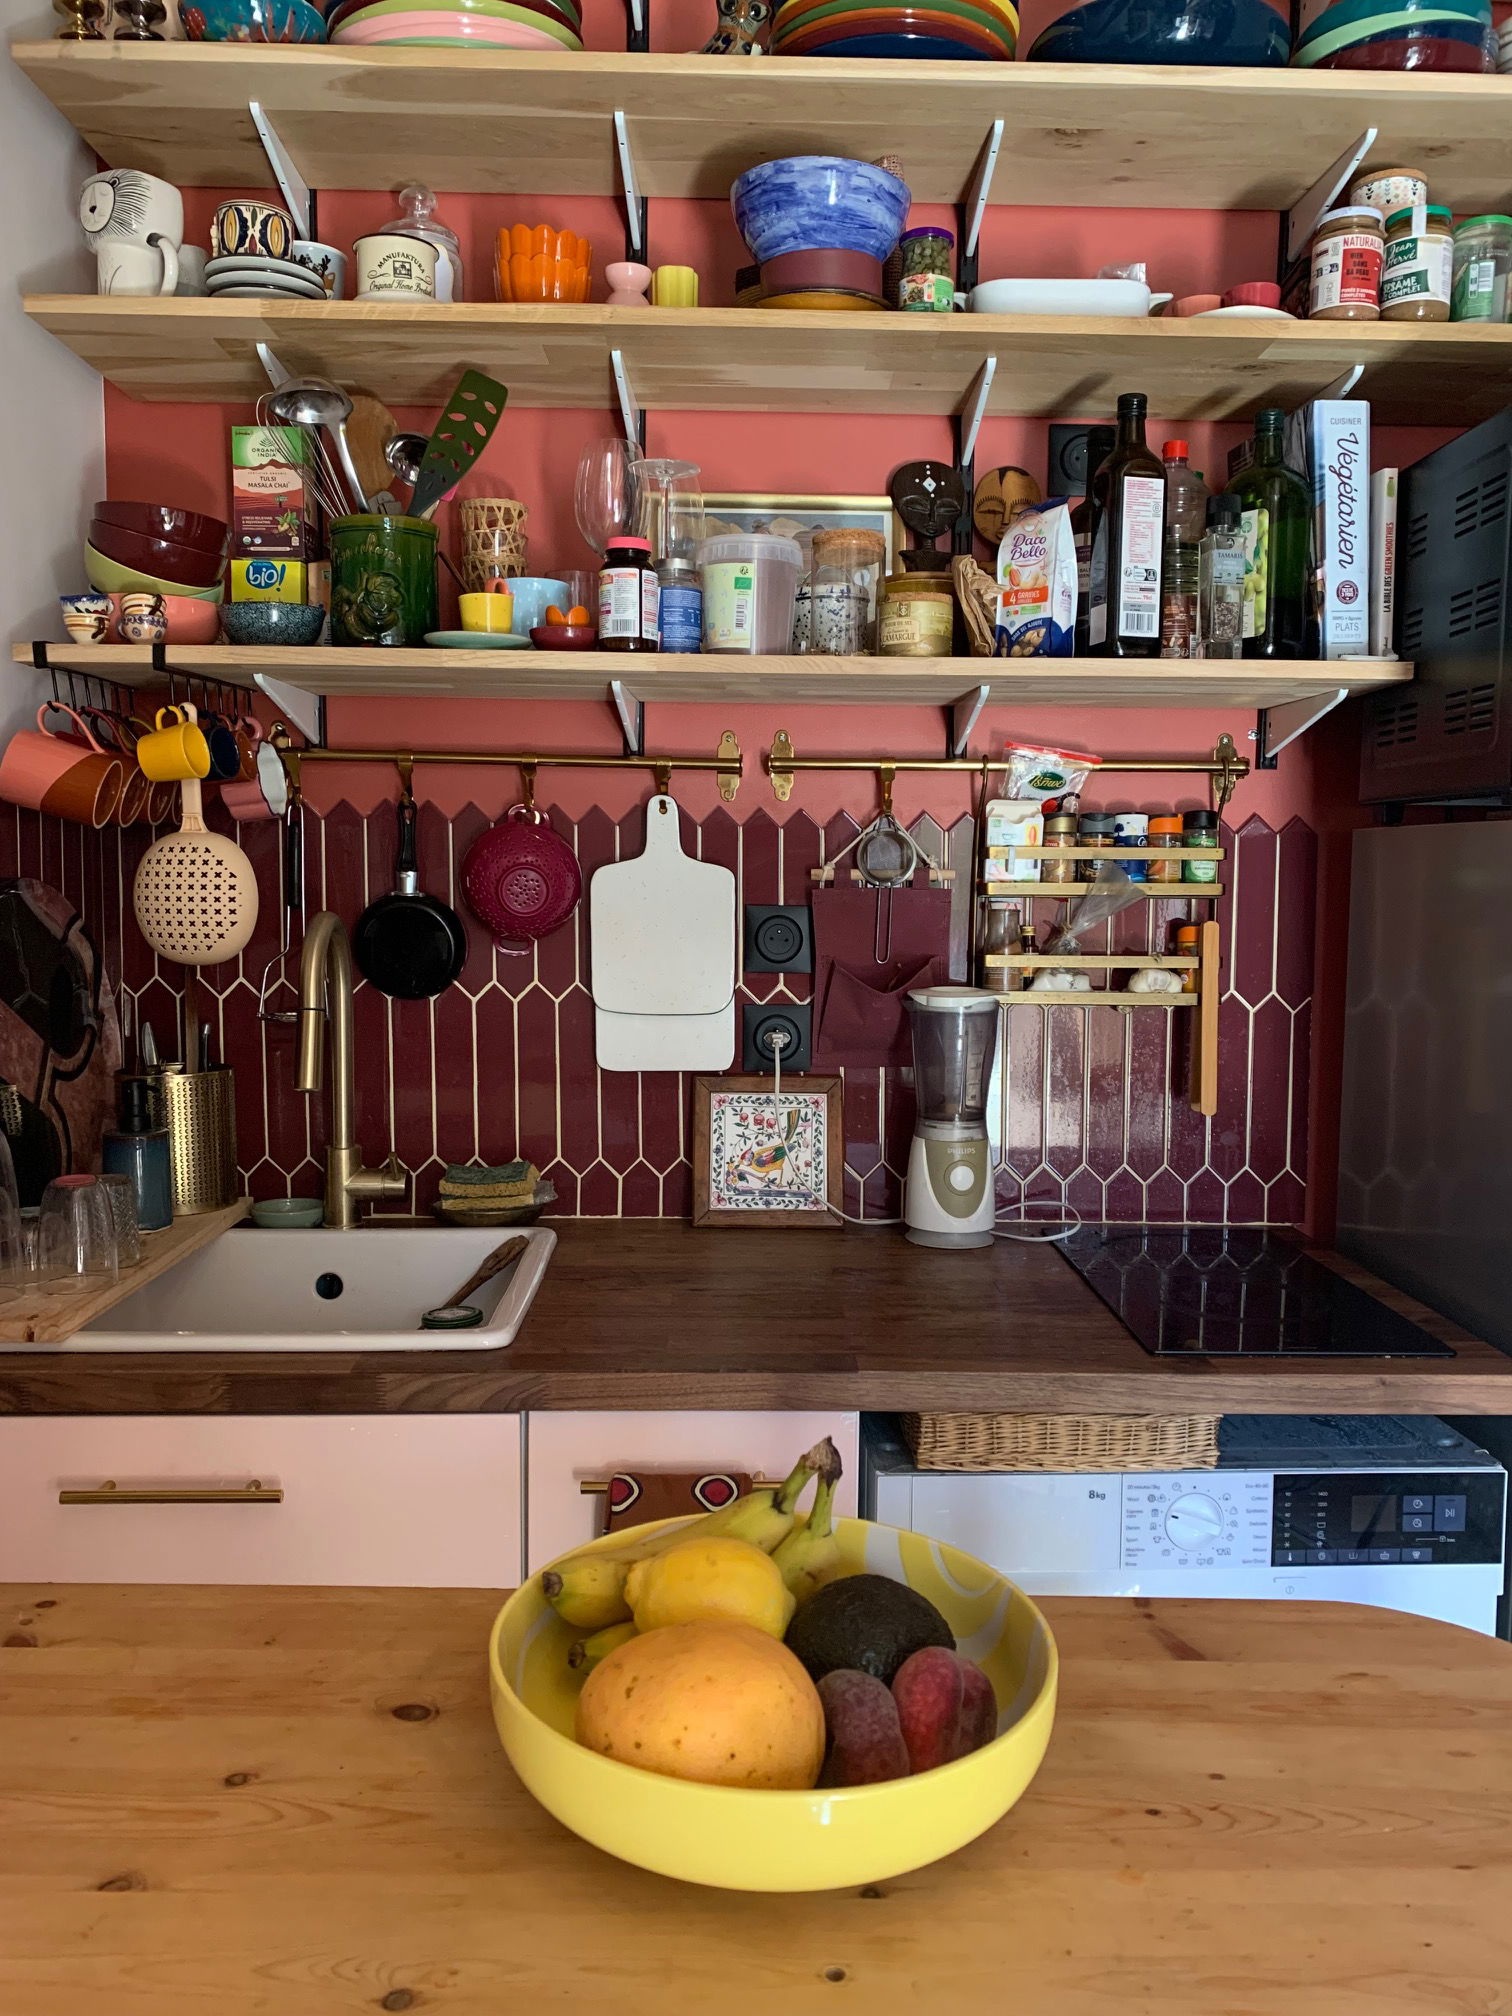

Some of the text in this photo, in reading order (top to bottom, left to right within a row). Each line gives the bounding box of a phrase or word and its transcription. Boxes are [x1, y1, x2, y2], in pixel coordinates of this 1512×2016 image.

[1389, 241, 1415, 255] Jean
[377, 251, 425, 274] MANUFAKTURA
[369, 279, 395, 291] Original
[395, 279, 413, 290] Home
[1330, 417, 1362, 425] CUISINER
[1328, 432, 1359, 570] Végétarien
[1013, 533, 1047, 548] Daco
[1010, 545, 1047, 560] Bello
[1217, 551, 1243, 559] TAMARIS
[1383, 522, 1394, 613] LA BIBLE DES GREEN SMOOTHIES
[1009, 592, 1016, 605] 4
[1335, 622, 1359, 632] PLATS
